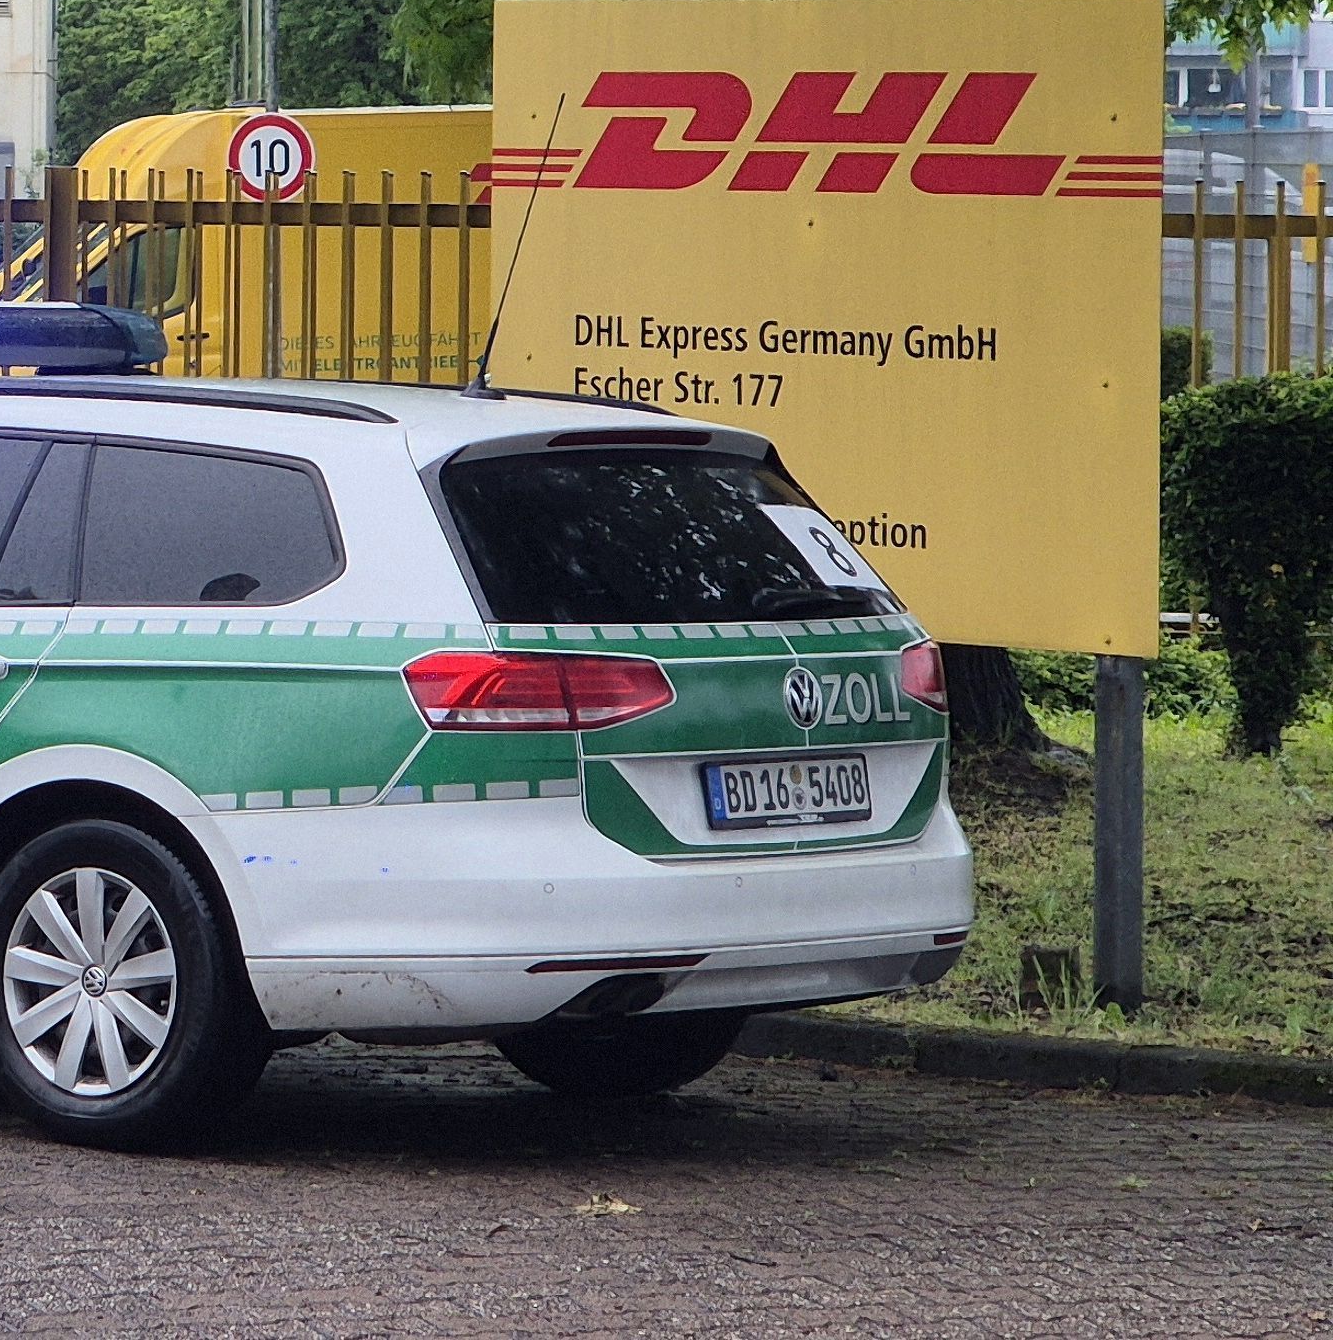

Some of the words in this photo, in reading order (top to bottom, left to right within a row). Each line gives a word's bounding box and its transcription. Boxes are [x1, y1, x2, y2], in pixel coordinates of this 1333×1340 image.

[251, 138, 290, 178] 10
[573, 70, 1068, 197] DHL
[574, 313, 630, 349] DHL
[639, 315, 749, 358] Express
[758, 319, 894, 367] Germany
[903, 324, 998, 362] GmbH
[574, 366, 664, 403] Escher
[673, 369, 721, 406] Str.
[731, 372, 784, 408] 177
[808, 526, 858, 578] 8
[820, 672, 911, 725] ZOLL
[807, 763, 866, 808] 5408
